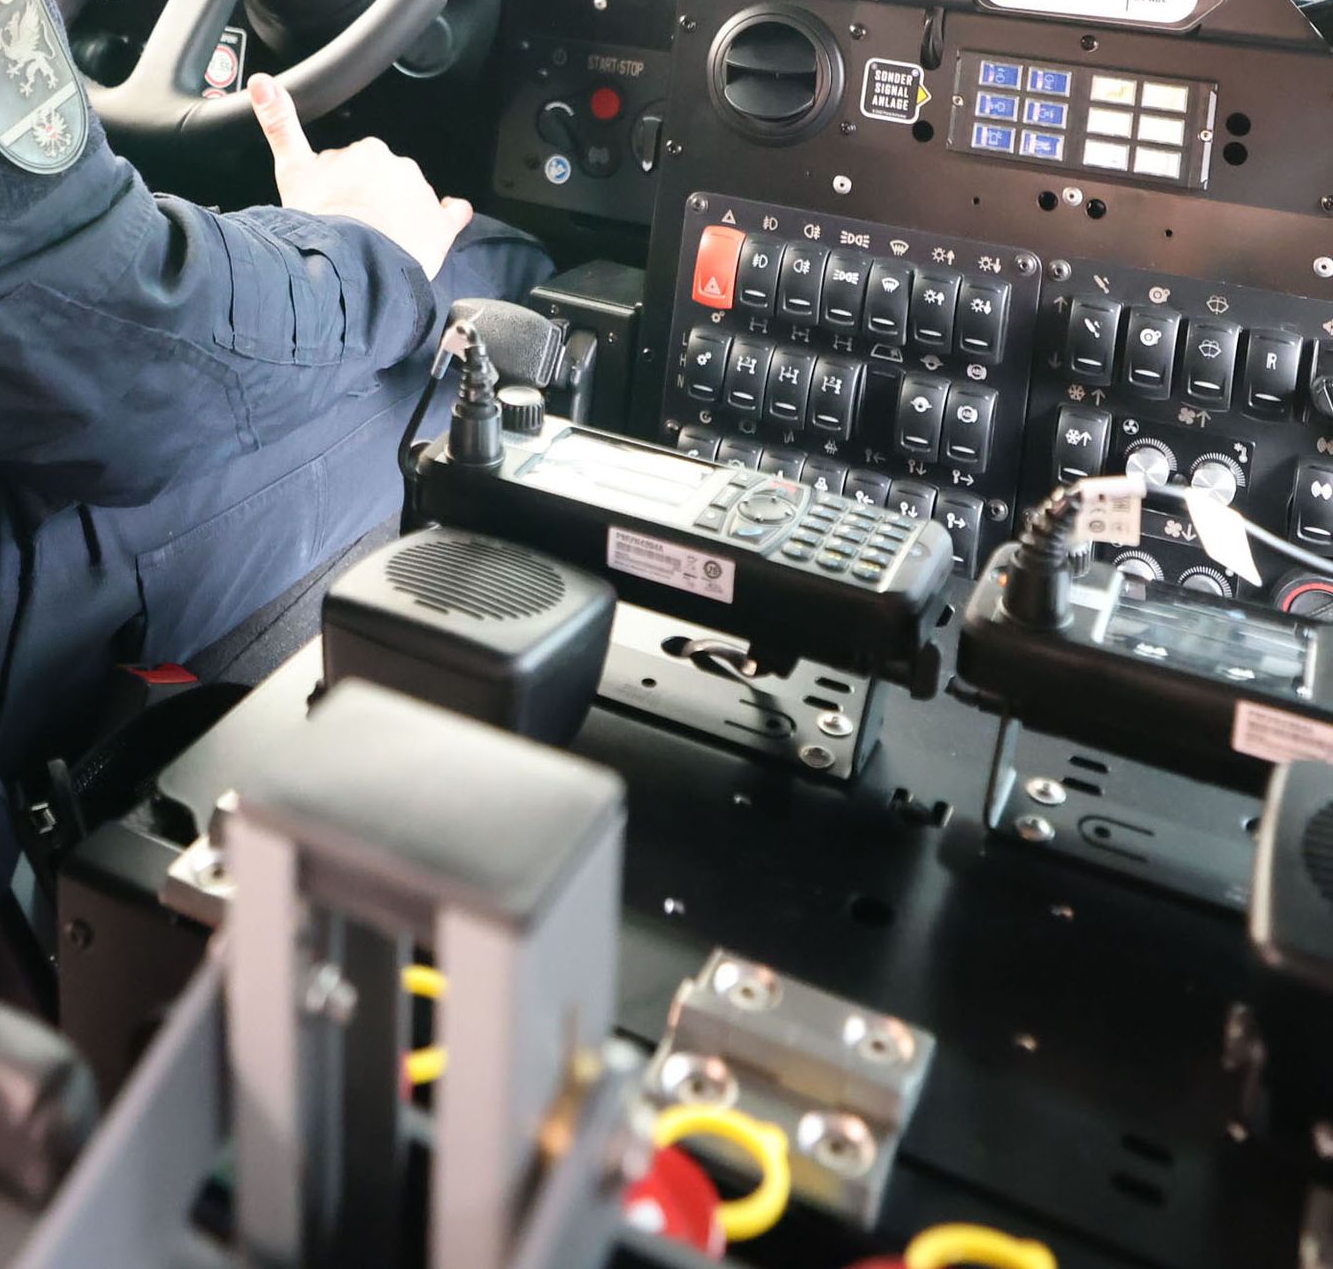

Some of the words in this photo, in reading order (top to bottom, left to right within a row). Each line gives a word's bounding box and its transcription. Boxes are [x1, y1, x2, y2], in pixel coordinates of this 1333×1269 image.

[874, 69, 914, 86] SONDER
[874, 81, 910, 98] SIGNAL
[871, 93, 910, 111] ANLAGE
